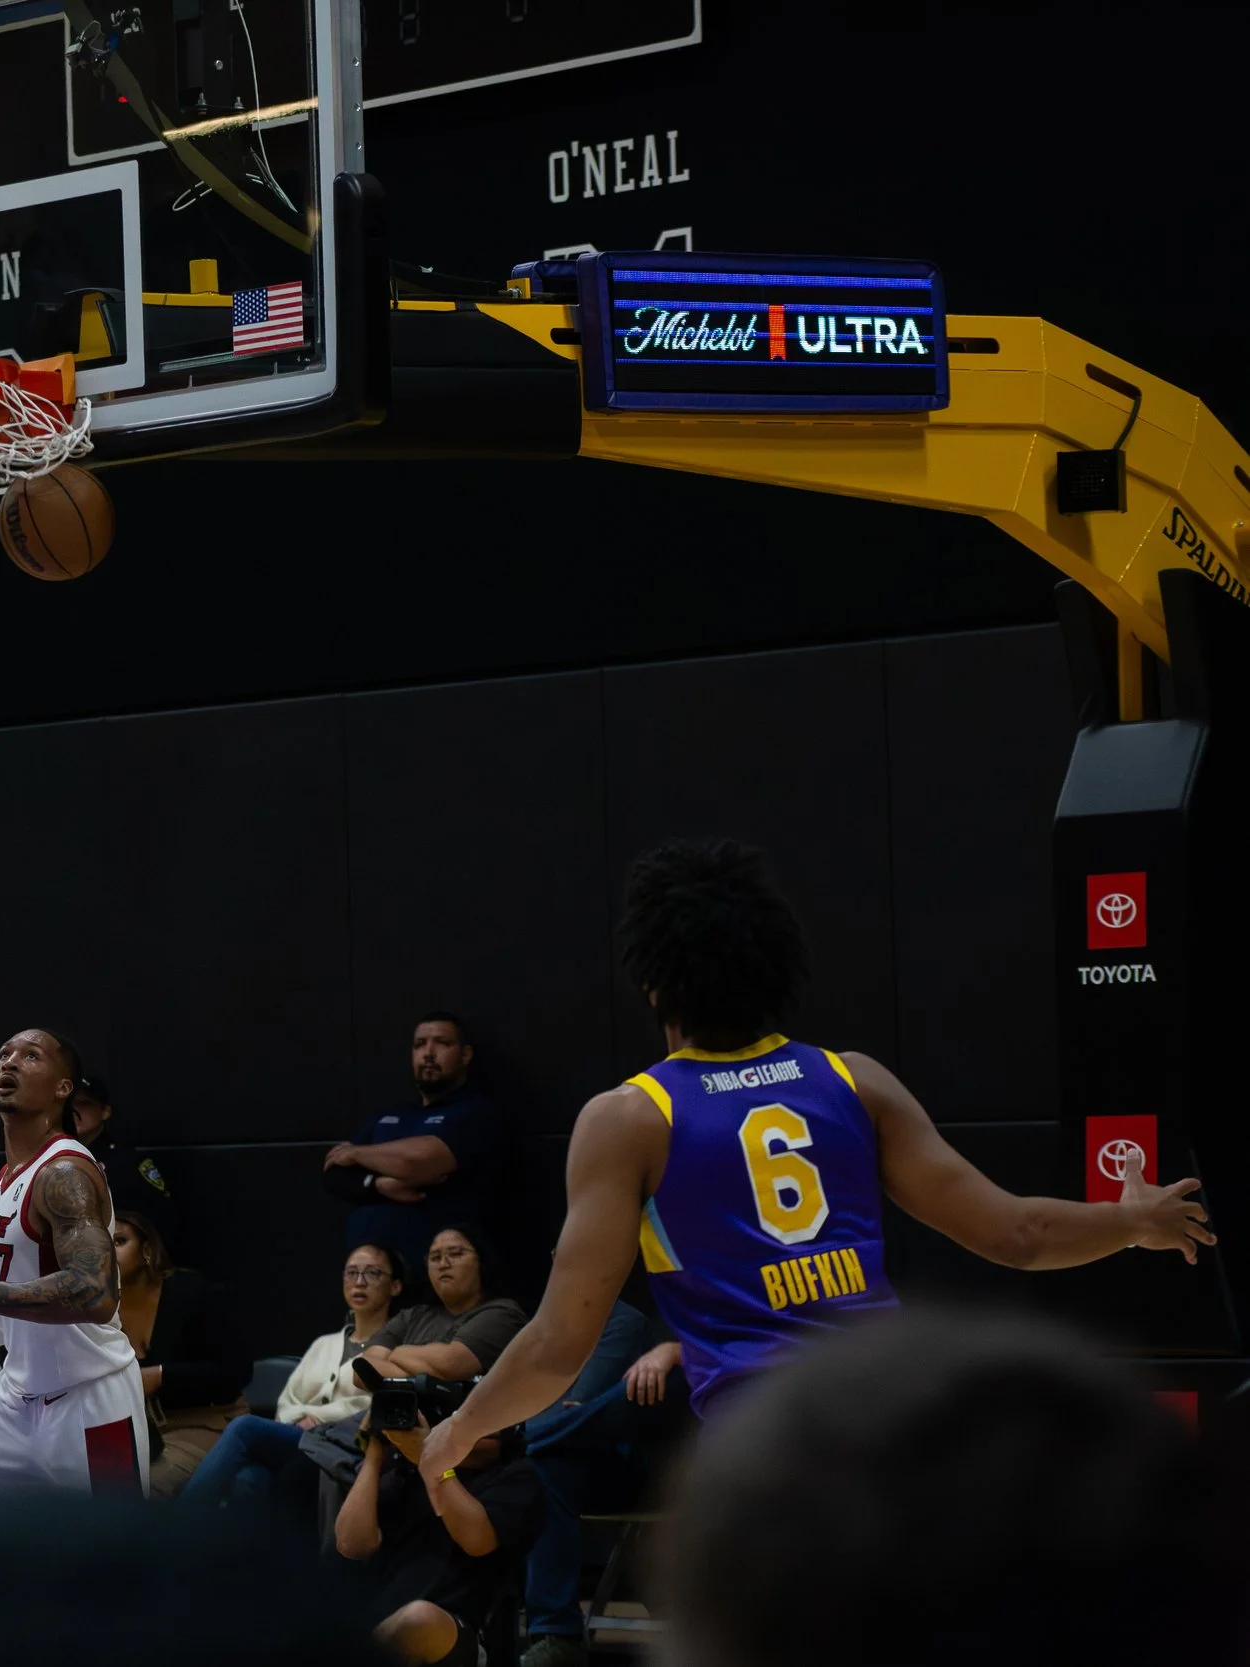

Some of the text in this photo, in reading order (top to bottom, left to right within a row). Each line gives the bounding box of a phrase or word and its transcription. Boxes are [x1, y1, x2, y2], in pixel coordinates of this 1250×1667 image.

[548, 130, 690, 204] O'NEAL
[798, 315, 925, 354] ULTRA
[1078, 964, 1157, 985] TOYOTA
[738, 1102, 830, 1245] 6
[760, 1248, 867, 1311] BUFKIN
